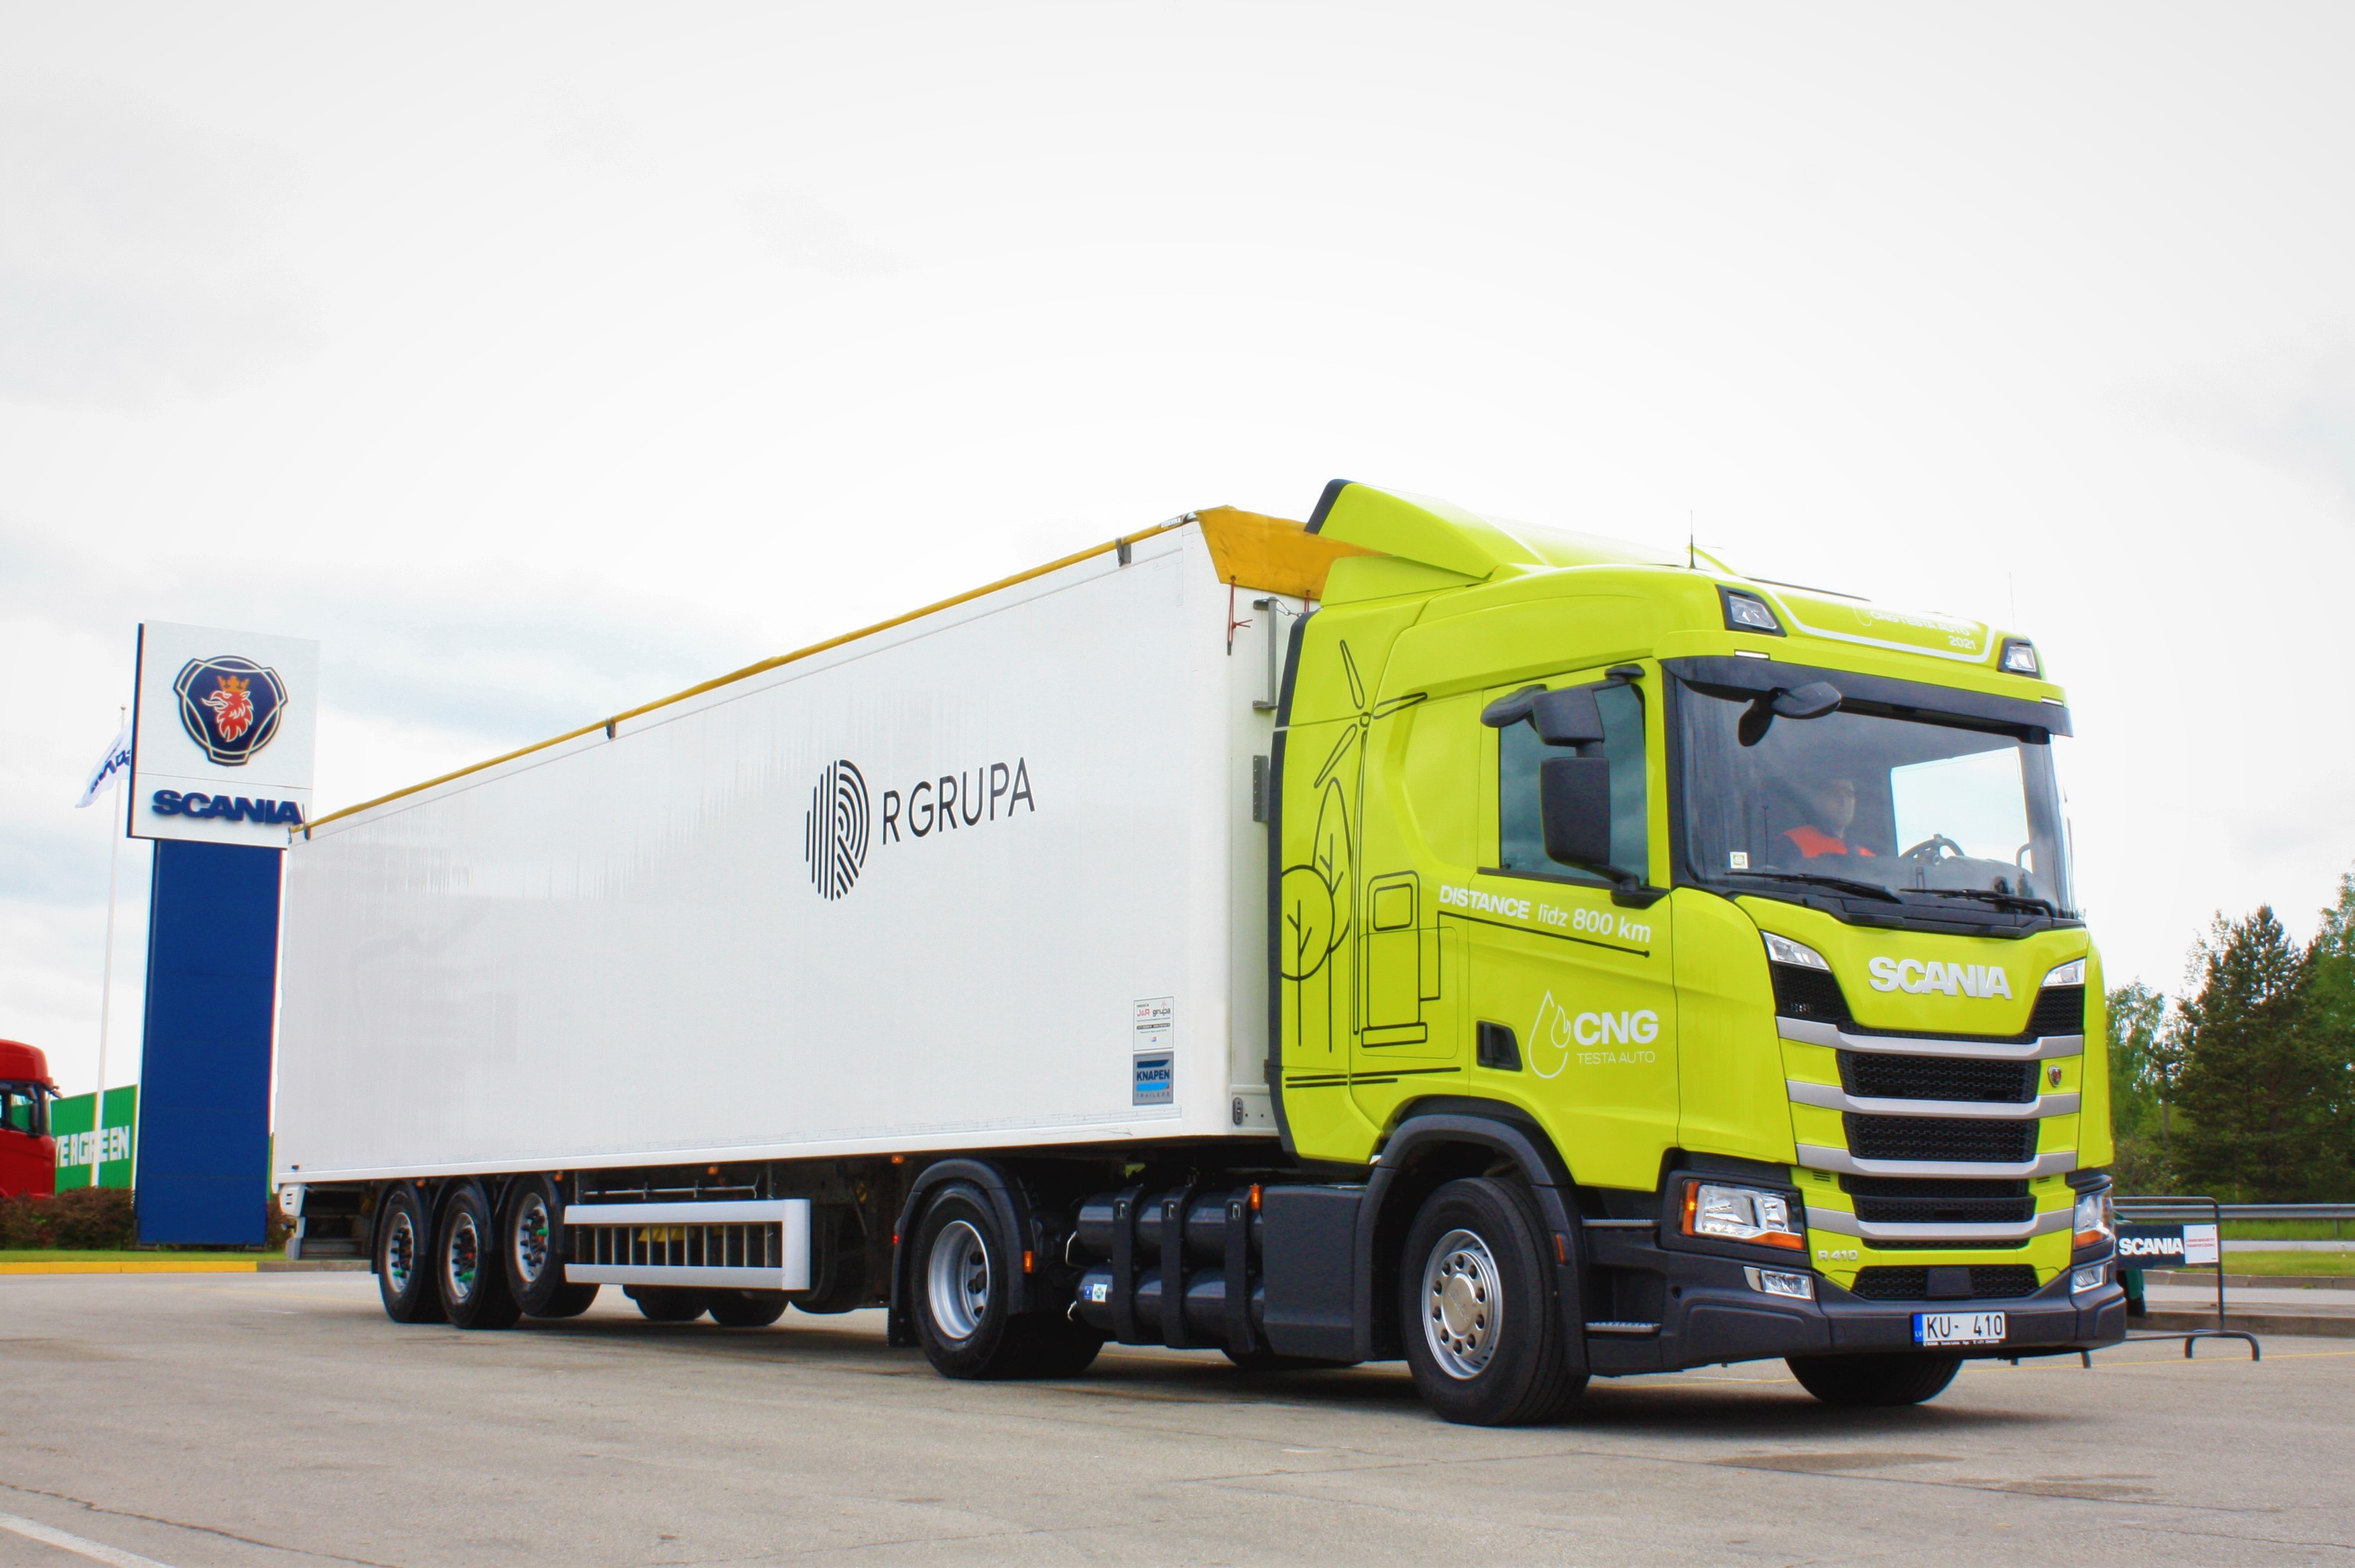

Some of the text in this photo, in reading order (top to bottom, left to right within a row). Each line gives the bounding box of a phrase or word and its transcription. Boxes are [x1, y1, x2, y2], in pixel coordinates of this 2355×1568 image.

[1948, 635, 1977, 651] 2021
[152, 789, 304, 825] SCANIA
[882, 757, 1036, 845] RGRUPA
[1439, 885, 1651, 943] DISTANCE līdz 800 km
[1869, 956, 2013, 1000] SCANIA
[1574, 1010, 1659, 1046] CNG
[1576, 1051, 1656, 1065] TESTA AUTO
[1136, 1069, 1170, 1081] KNAPEN
[1817, 1250, 1859, 1261] R 410
[2119, 1238, 2184, 1255] SCANIA
[1973, 1314, 2003, 1337] 410
